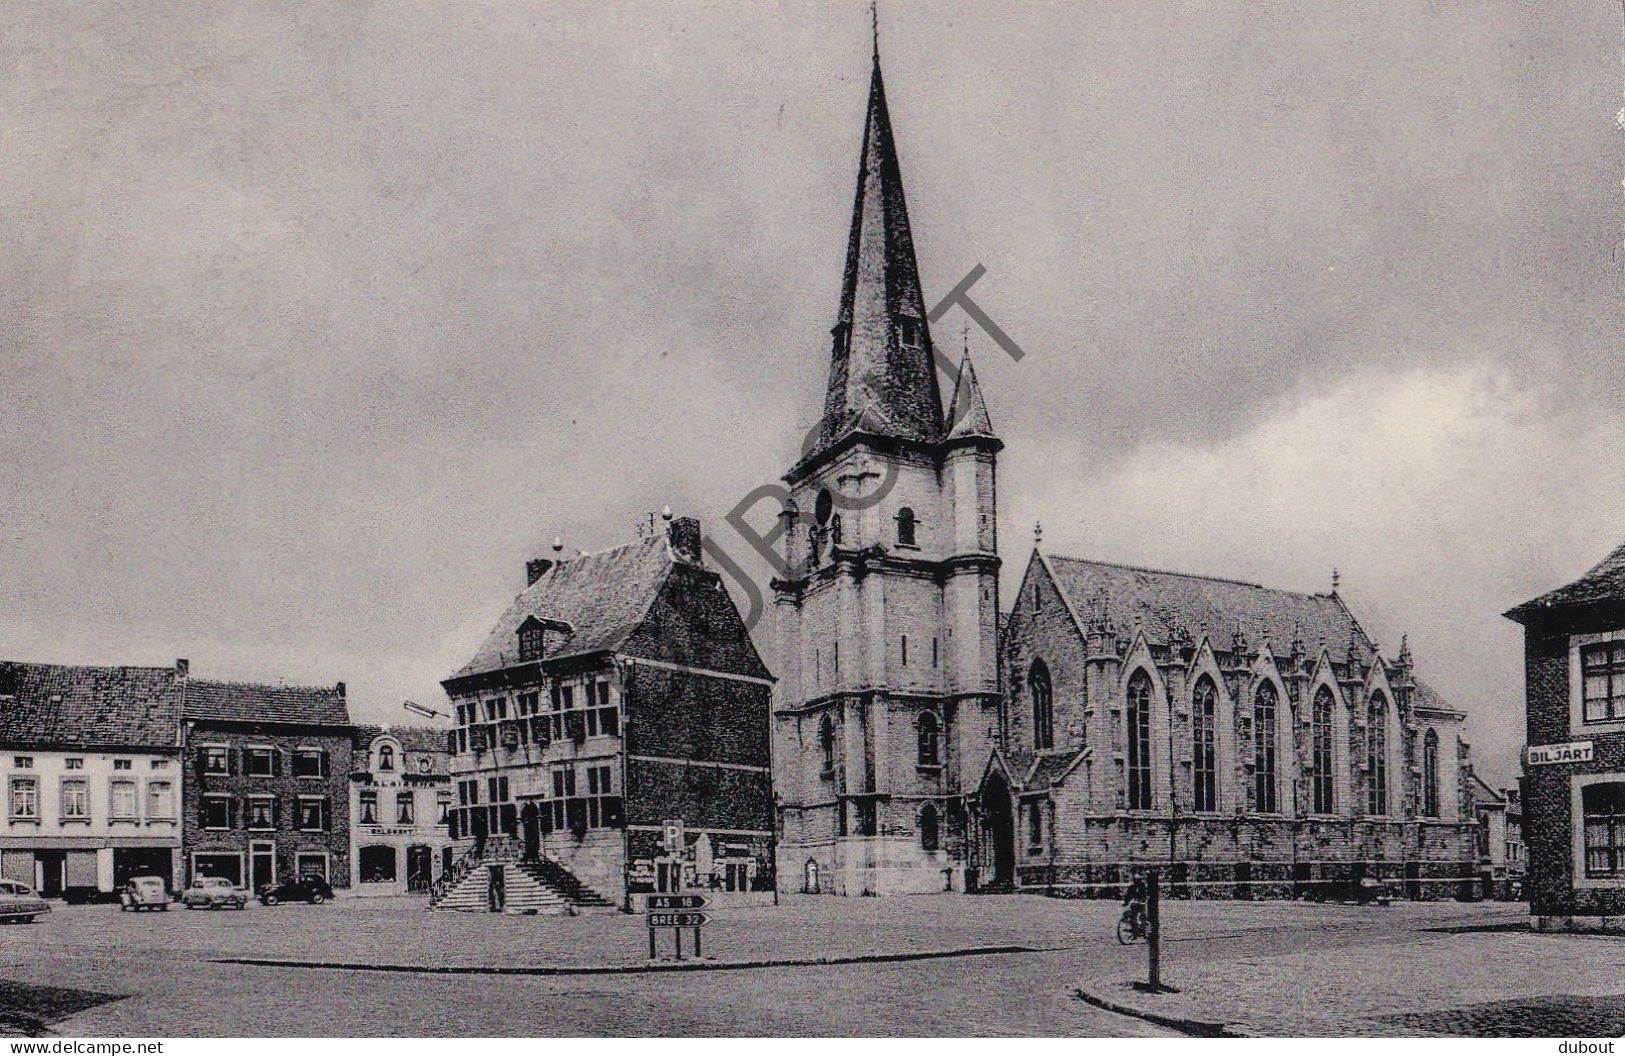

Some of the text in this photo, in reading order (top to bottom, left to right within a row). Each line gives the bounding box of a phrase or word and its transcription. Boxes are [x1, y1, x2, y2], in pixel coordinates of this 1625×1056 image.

[667, 826, 680, 845] P
[656, 897, 670, 908] AS
[651, 915, 700, 925] BREE 32
